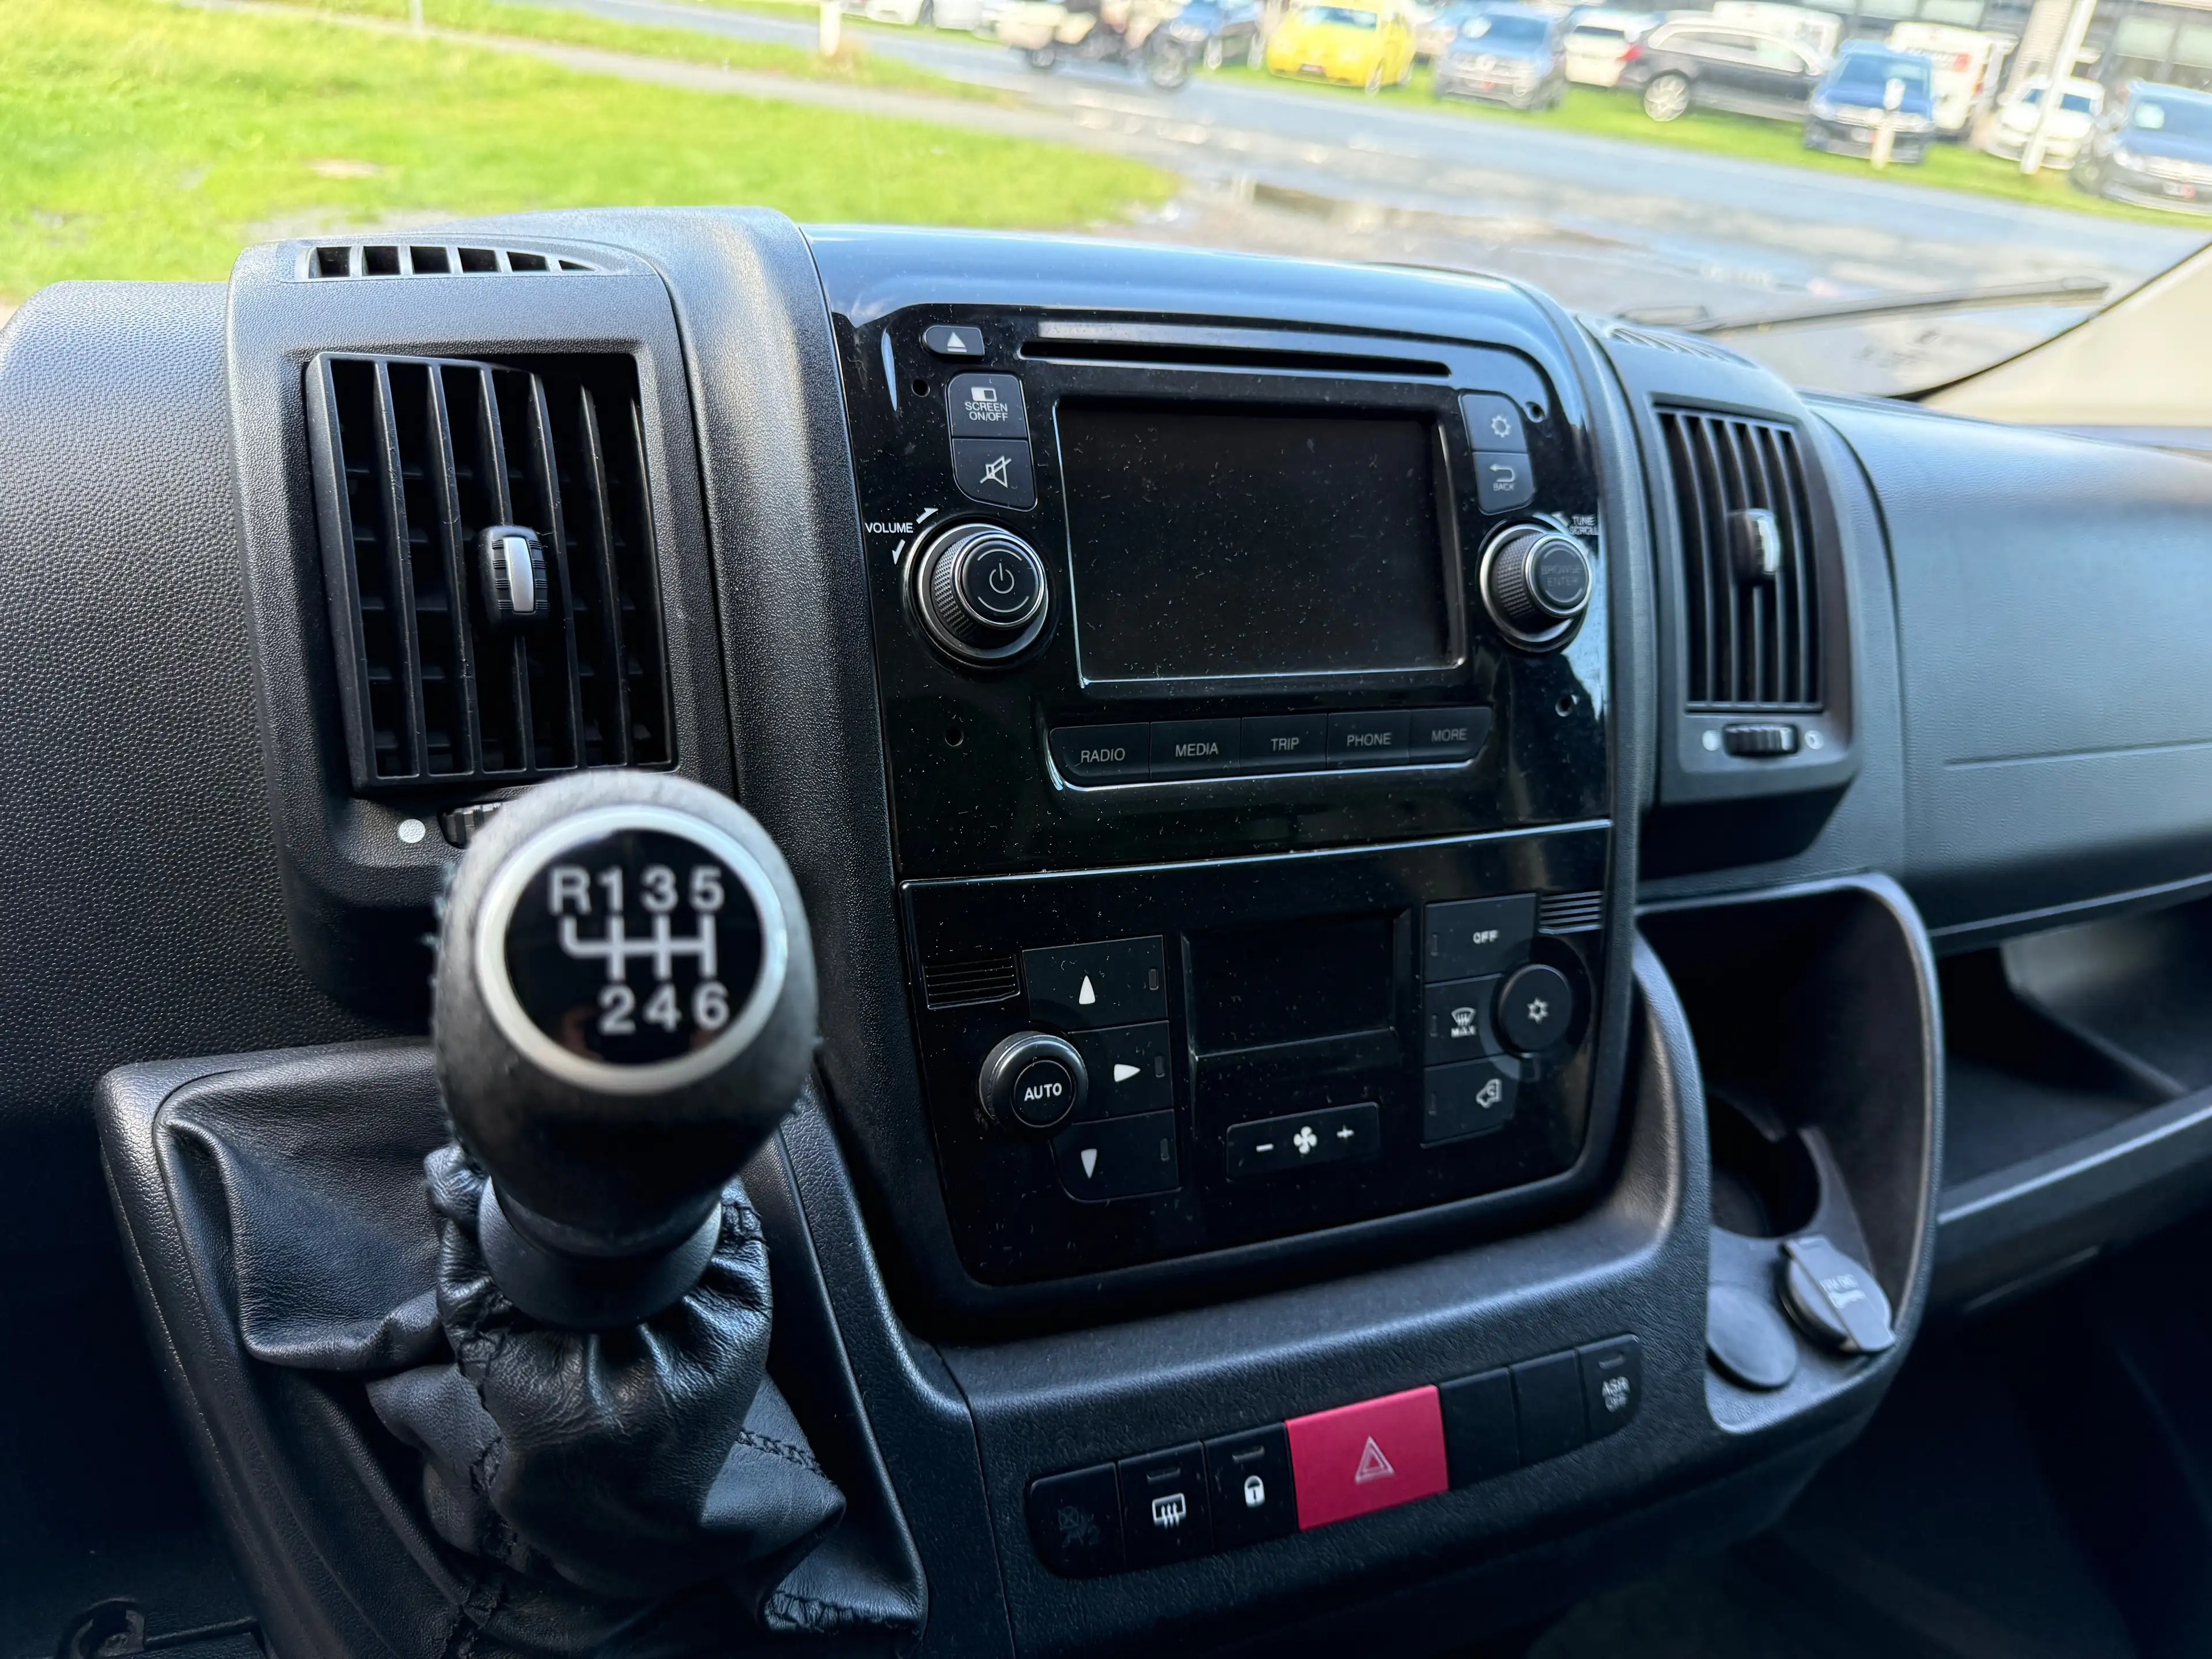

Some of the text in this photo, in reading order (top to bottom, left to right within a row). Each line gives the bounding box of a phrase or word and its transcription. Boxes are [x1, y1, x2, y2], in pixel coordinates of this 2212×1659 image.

[965, 402, 1008, 412] SCREEN
[969, 411, 1009, 422] ON/OFF
[1493, 482, 1516, 492] BACK
[865, 522, 914, 533] VOLUME
[1081, 728, 1468, 763] RADIO MEDIA TRIP PHONE MORE
[1473, 930, 1499, 944] OFF
[1450, 1025, 1476, 1038] MAX
[1024, 1083, 1062, 1102] AUTO
